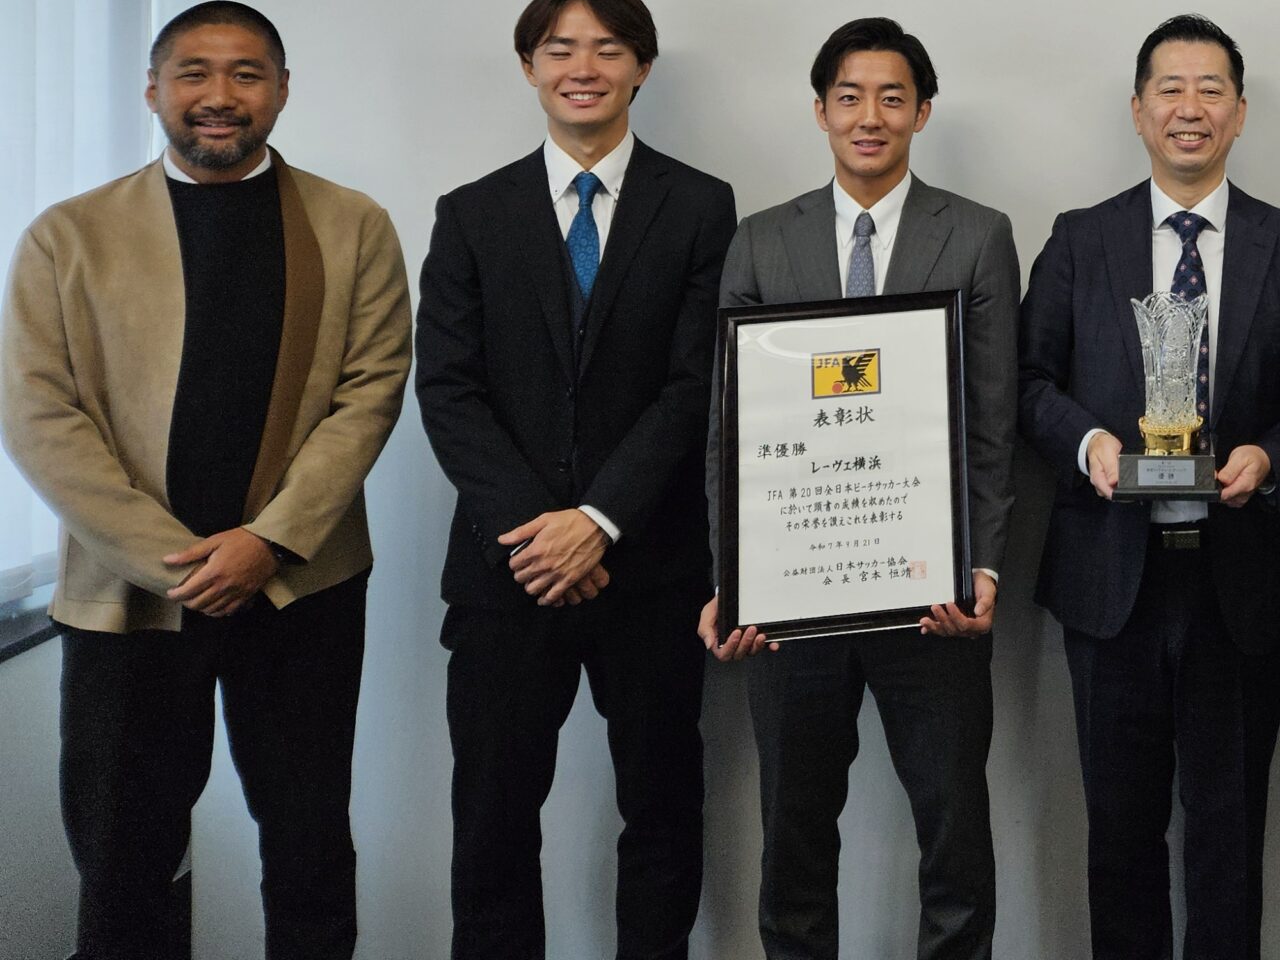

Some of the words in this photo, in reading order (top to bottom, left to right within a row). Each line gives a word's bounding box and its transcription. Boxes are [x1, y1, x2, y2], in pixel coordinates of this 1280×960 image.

[815, 357, 840, 369] JFA
[813, 406, 876, 428] 表彰状
[757, 441, 808, 460] 準優勝
[811, 455, 882, 474] レーヴェ横浜
[767, 490, 783, 502] JFA
